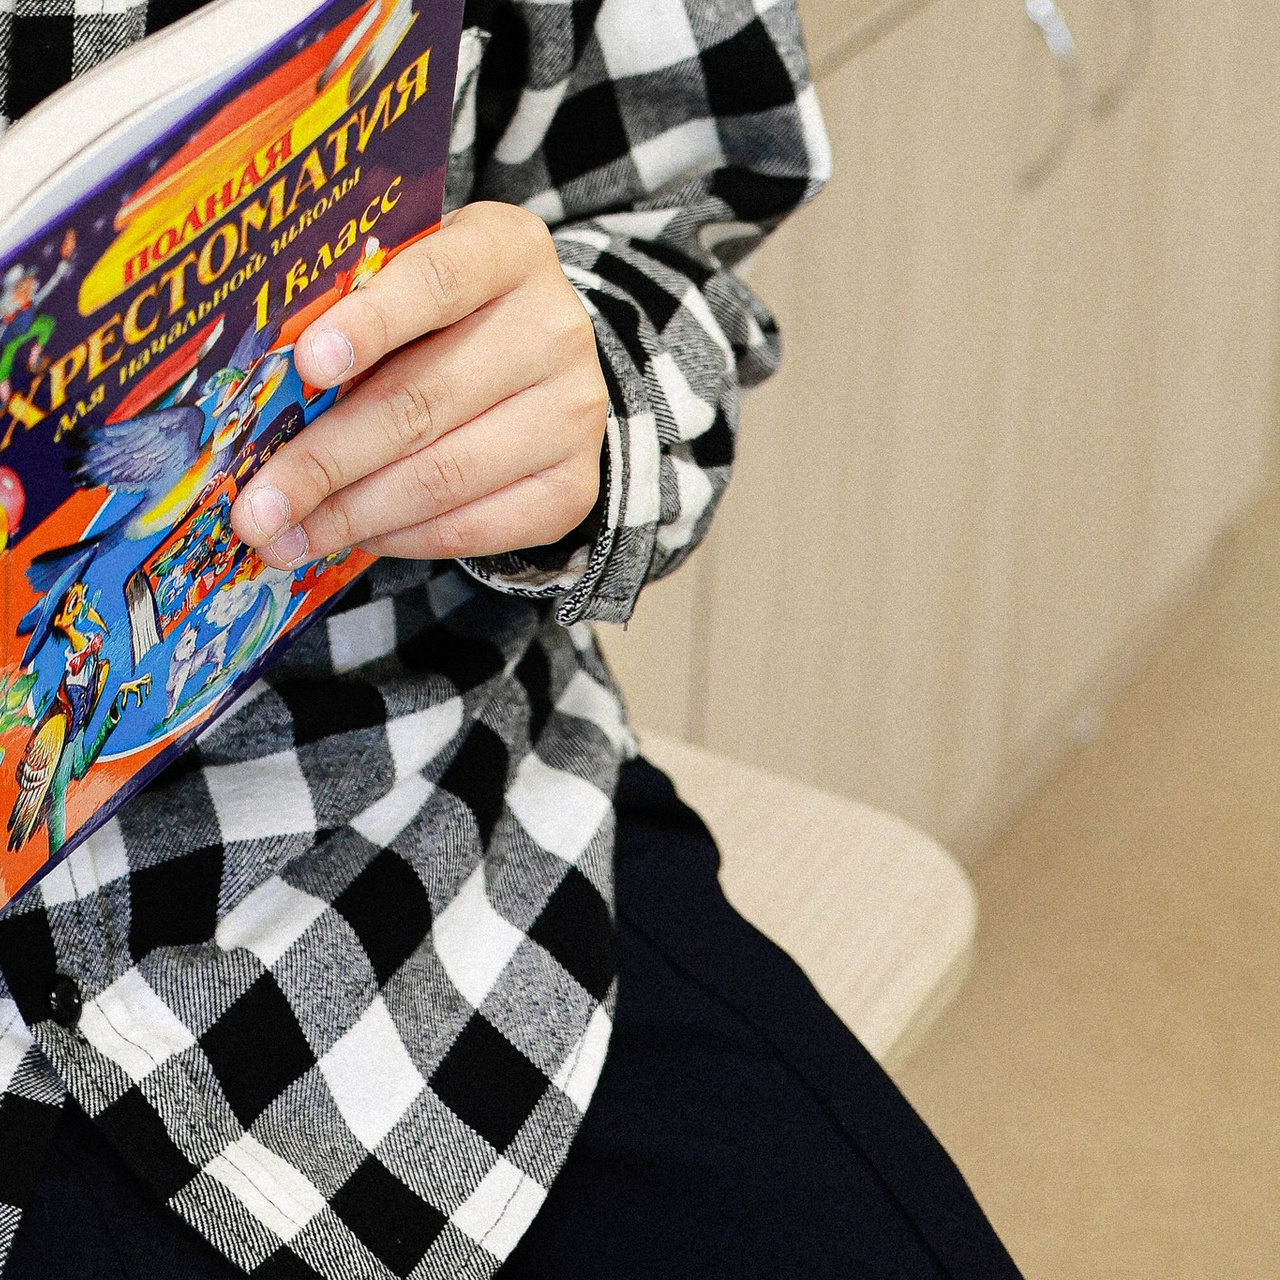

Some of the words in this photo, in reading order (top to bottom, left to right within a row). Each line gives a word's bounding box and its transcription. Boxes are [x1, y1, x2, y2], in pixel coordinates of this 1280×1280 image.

[121, 122, 295, 290] ПОЛНАЯ
[250, 276, 271, 339] 1
[282, 169, 405, 309] класс
[53, 380, 106, 446] для
[117, 242, 268, 388] начальной
[270, 161, 362, 259] школы
